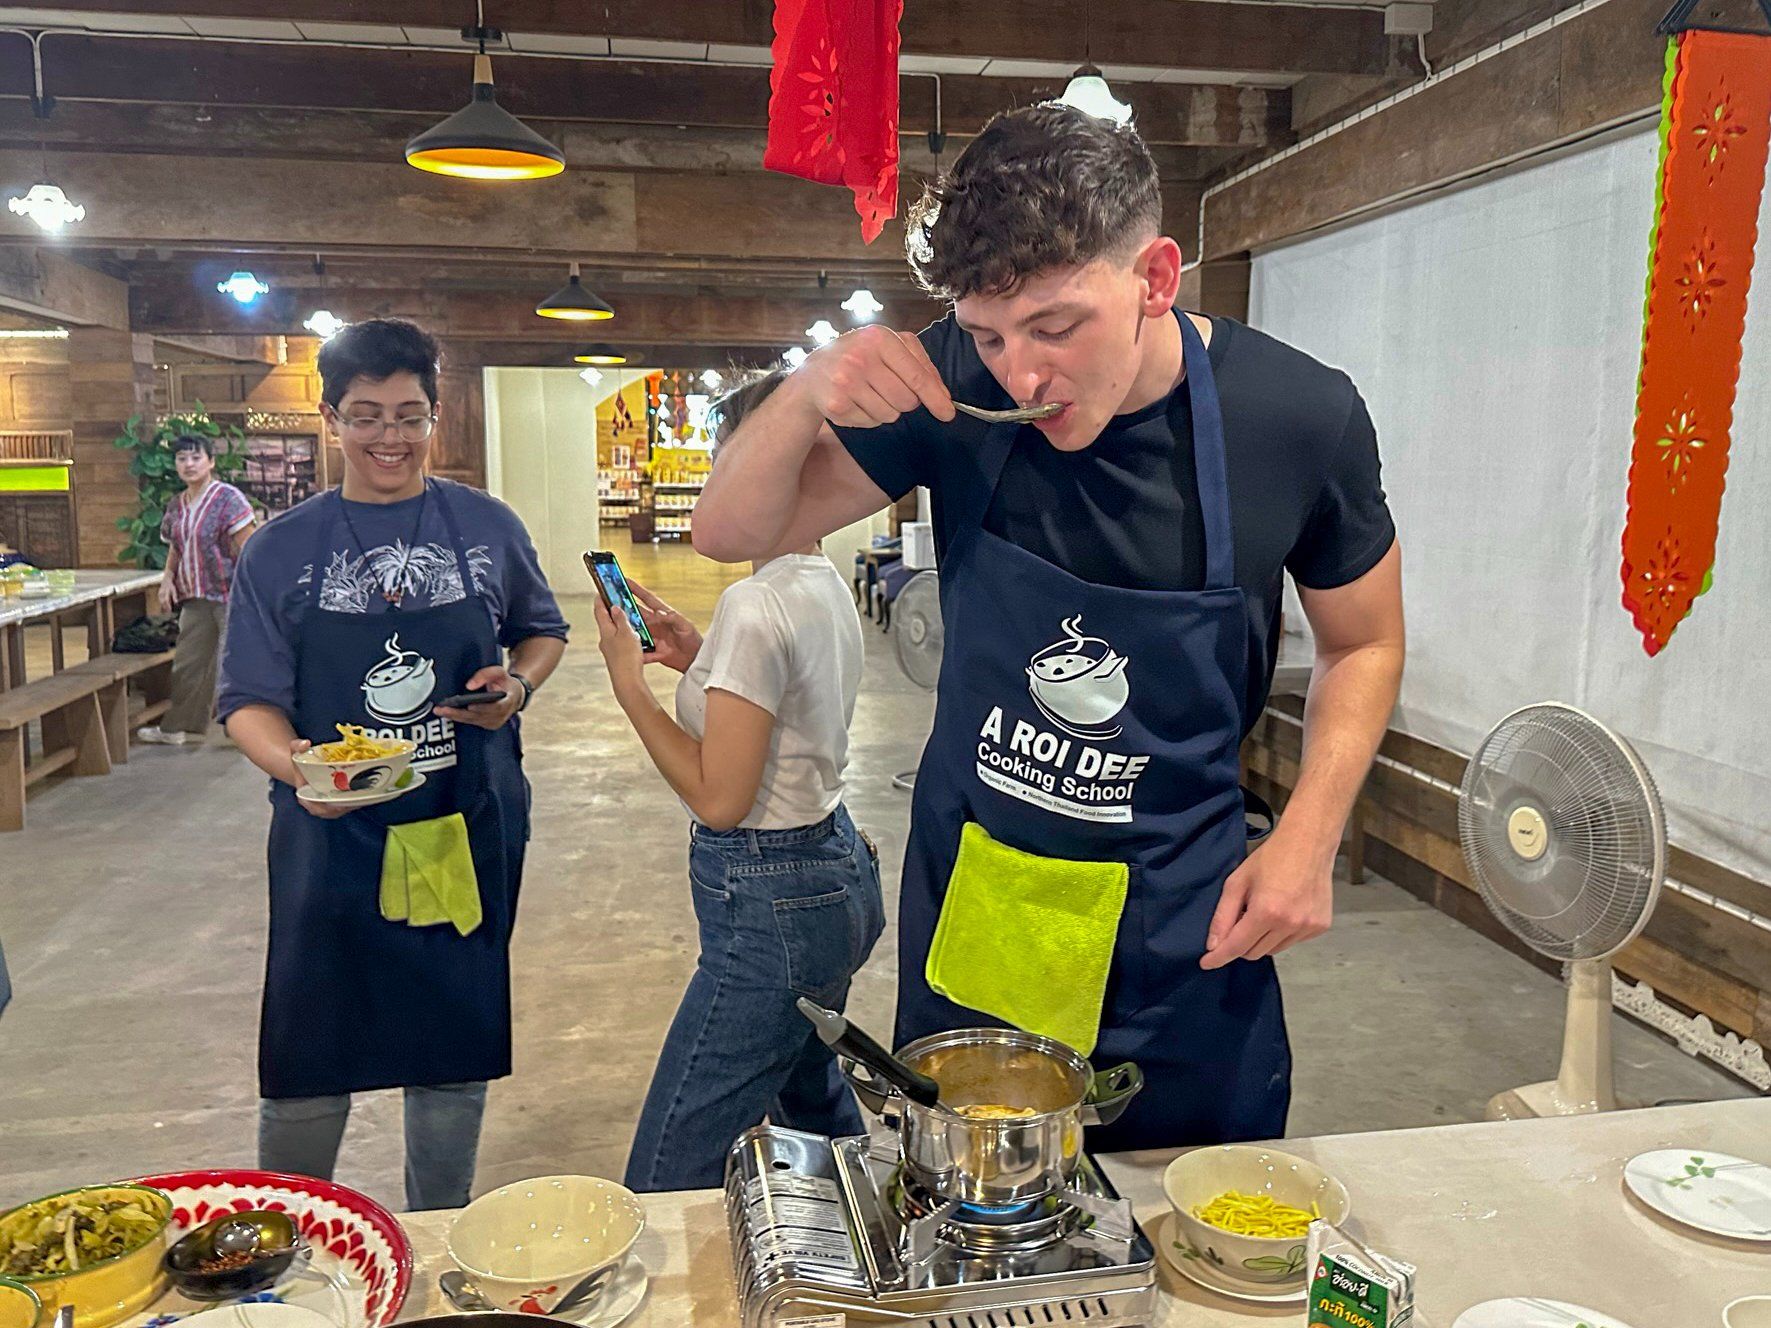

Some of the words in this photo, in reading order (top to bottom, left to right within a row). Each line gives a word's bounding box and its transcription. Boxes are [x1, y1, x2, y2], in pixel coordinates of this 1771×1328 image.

[411, 717, 456, 745] DEE
[979, 705, 1003, 745] A
[1009, 719, 1072, 769] ROI
[1075, 746, 1151, 780] DEE
[977, 742, 1056, 793] Cooking
[1061, 776, 1134, 801] School
[1053, 801, 1079, 814] Thailand
